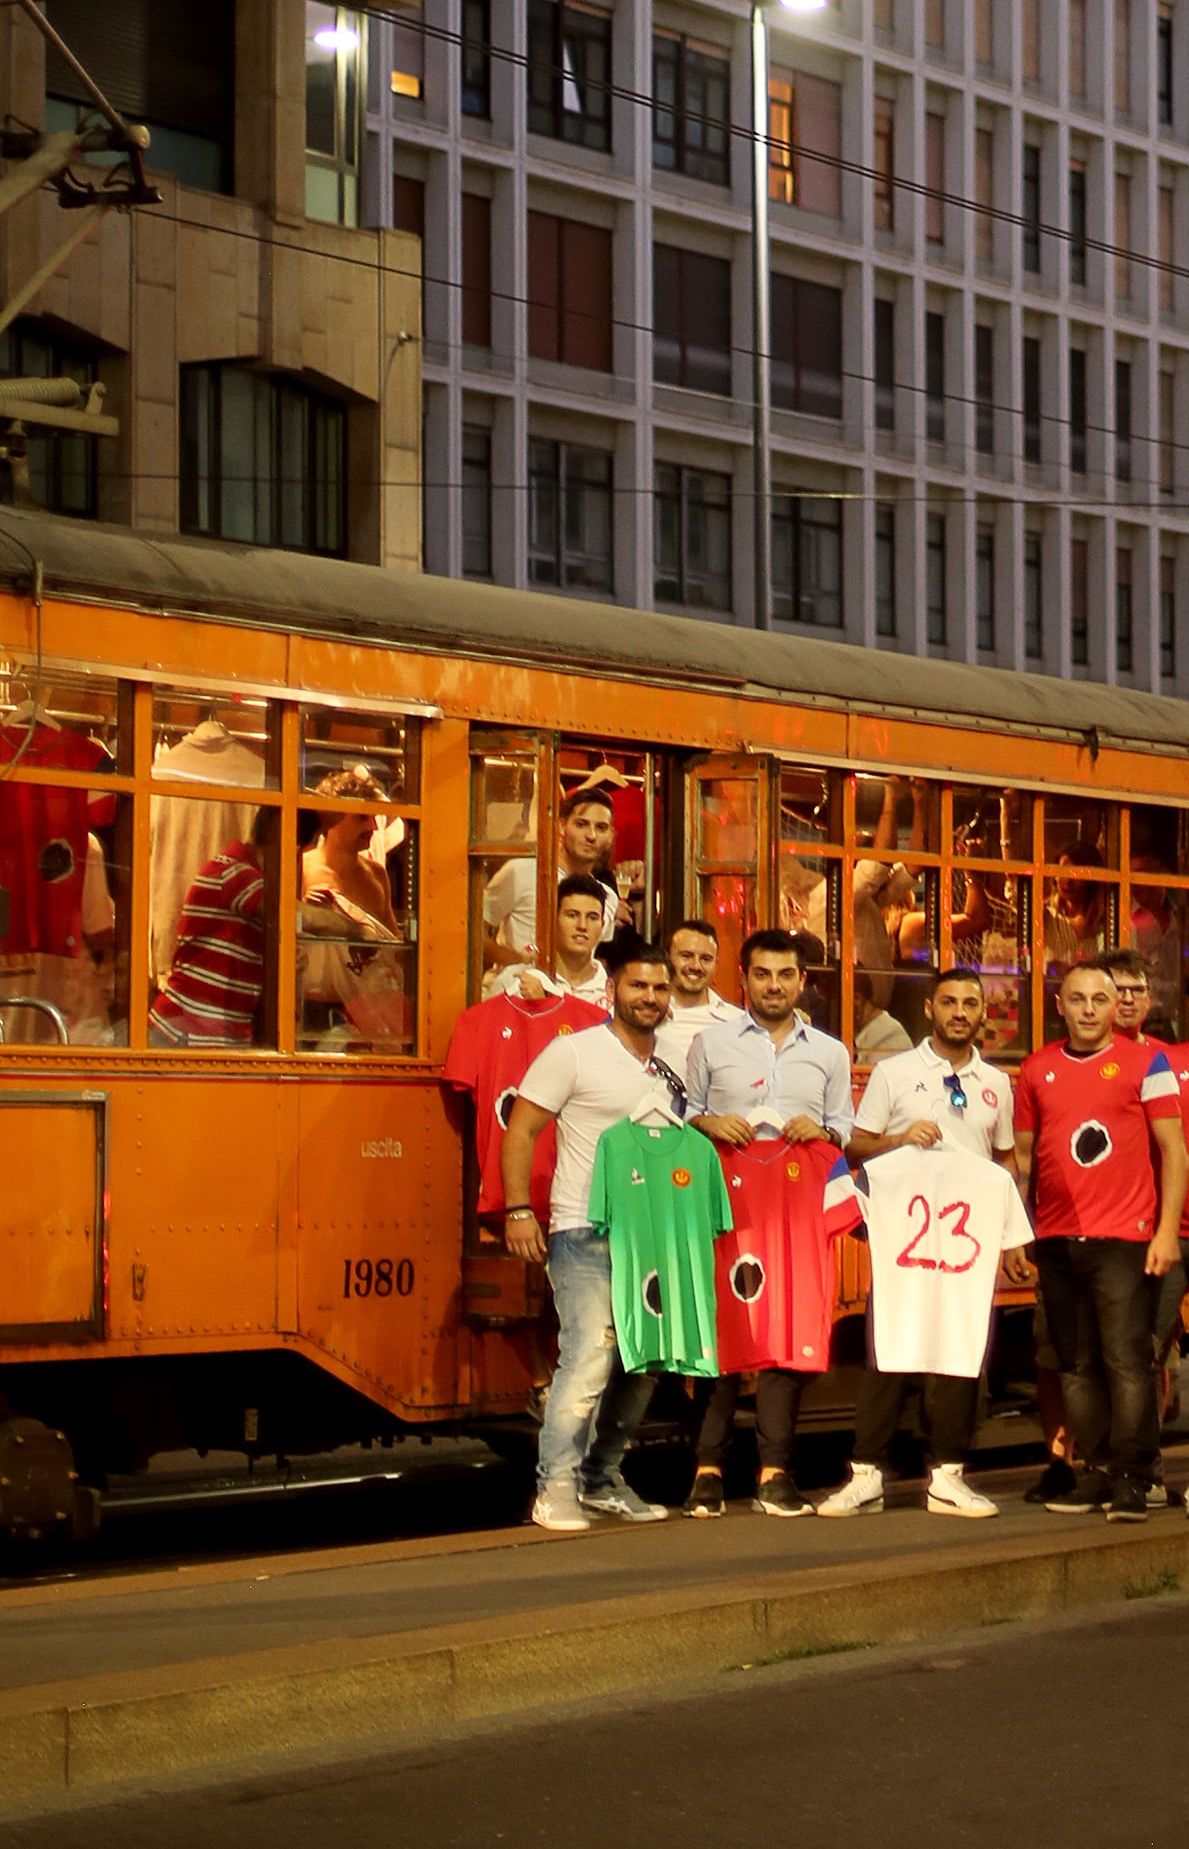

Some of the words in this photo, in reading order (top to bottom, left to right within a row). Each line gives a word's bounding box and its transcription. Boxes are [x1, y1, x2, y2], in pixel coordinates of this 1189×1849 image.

[361, 1136, 402, 1158] uscita
[896, 1194, 982, 1274] 23
[343, 1258, 415, 1299] 1980
